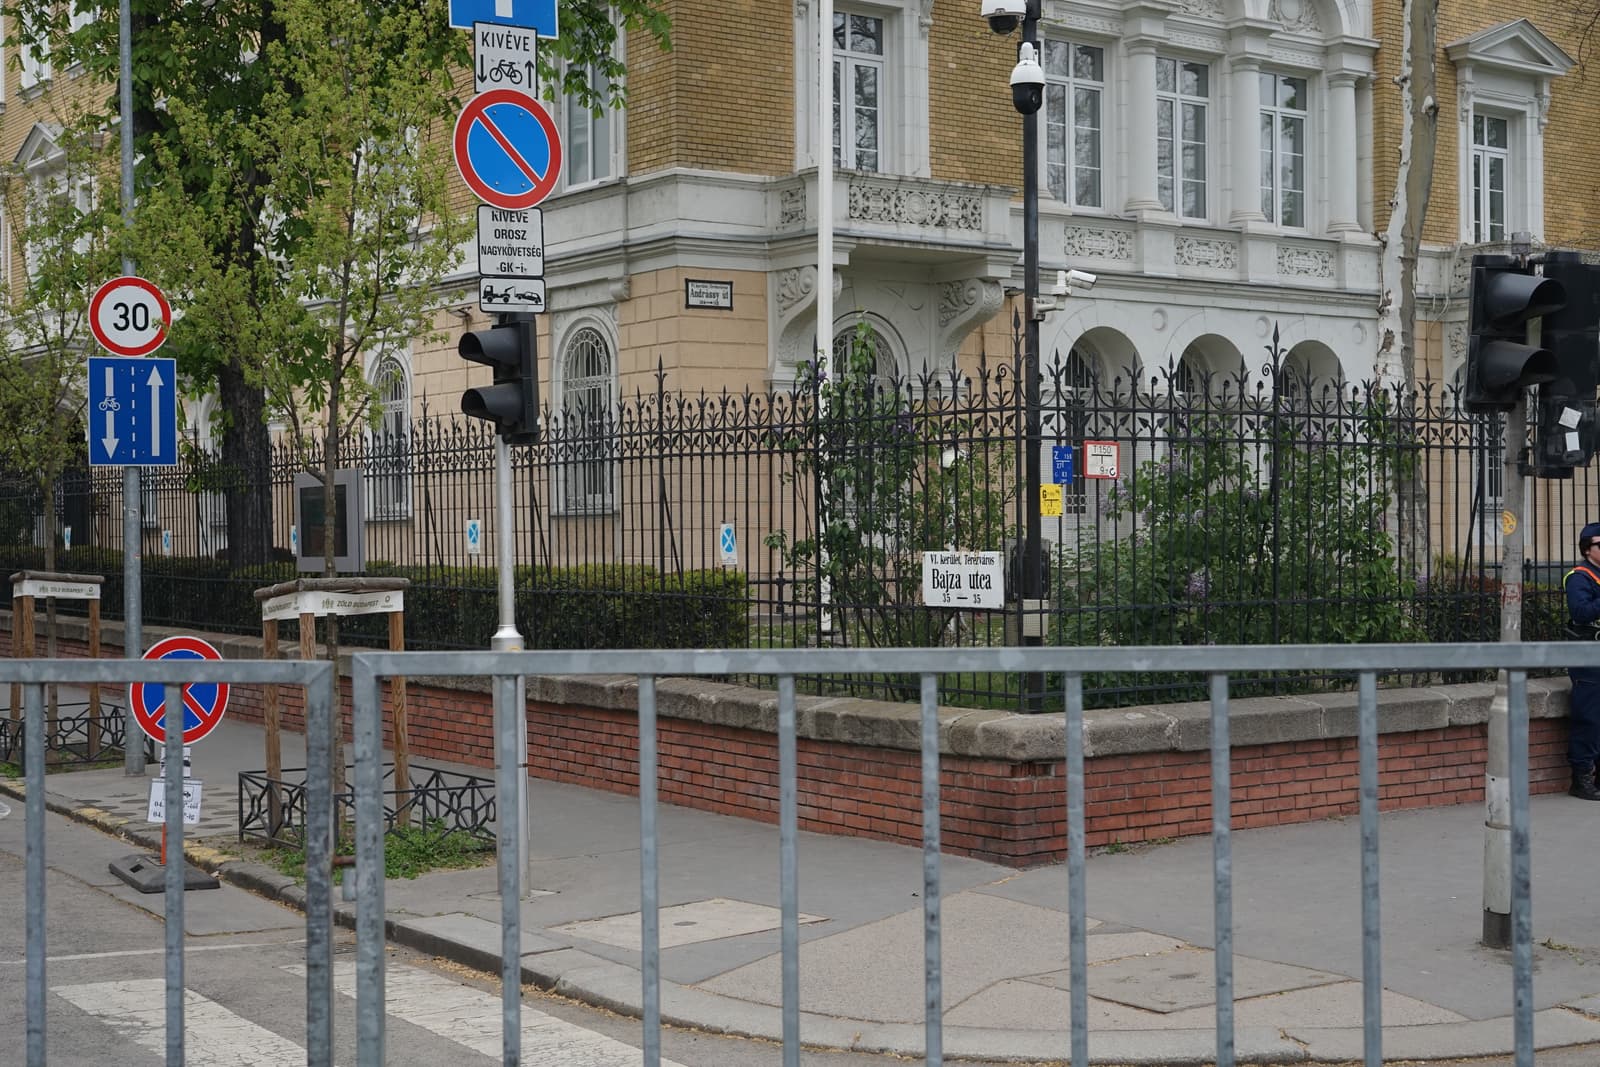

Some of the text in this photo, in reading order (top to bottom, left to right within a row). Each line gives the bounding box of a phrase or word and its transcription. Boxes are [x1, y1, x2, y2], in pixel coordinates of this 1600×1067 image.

[494, 228, 527, 240] OROSZ
[481, 245, 541, 257] NAGYKÖVETSÉG
[113, 302, 149, 332] 30
[930, 554, 938, 564] VI.
[940, 554, 961, 566] kerület,
[932, 568, 991, 592] Bajza utca
[942, 593, 951, 603] 35
[973, 594, 981, 604] 35
